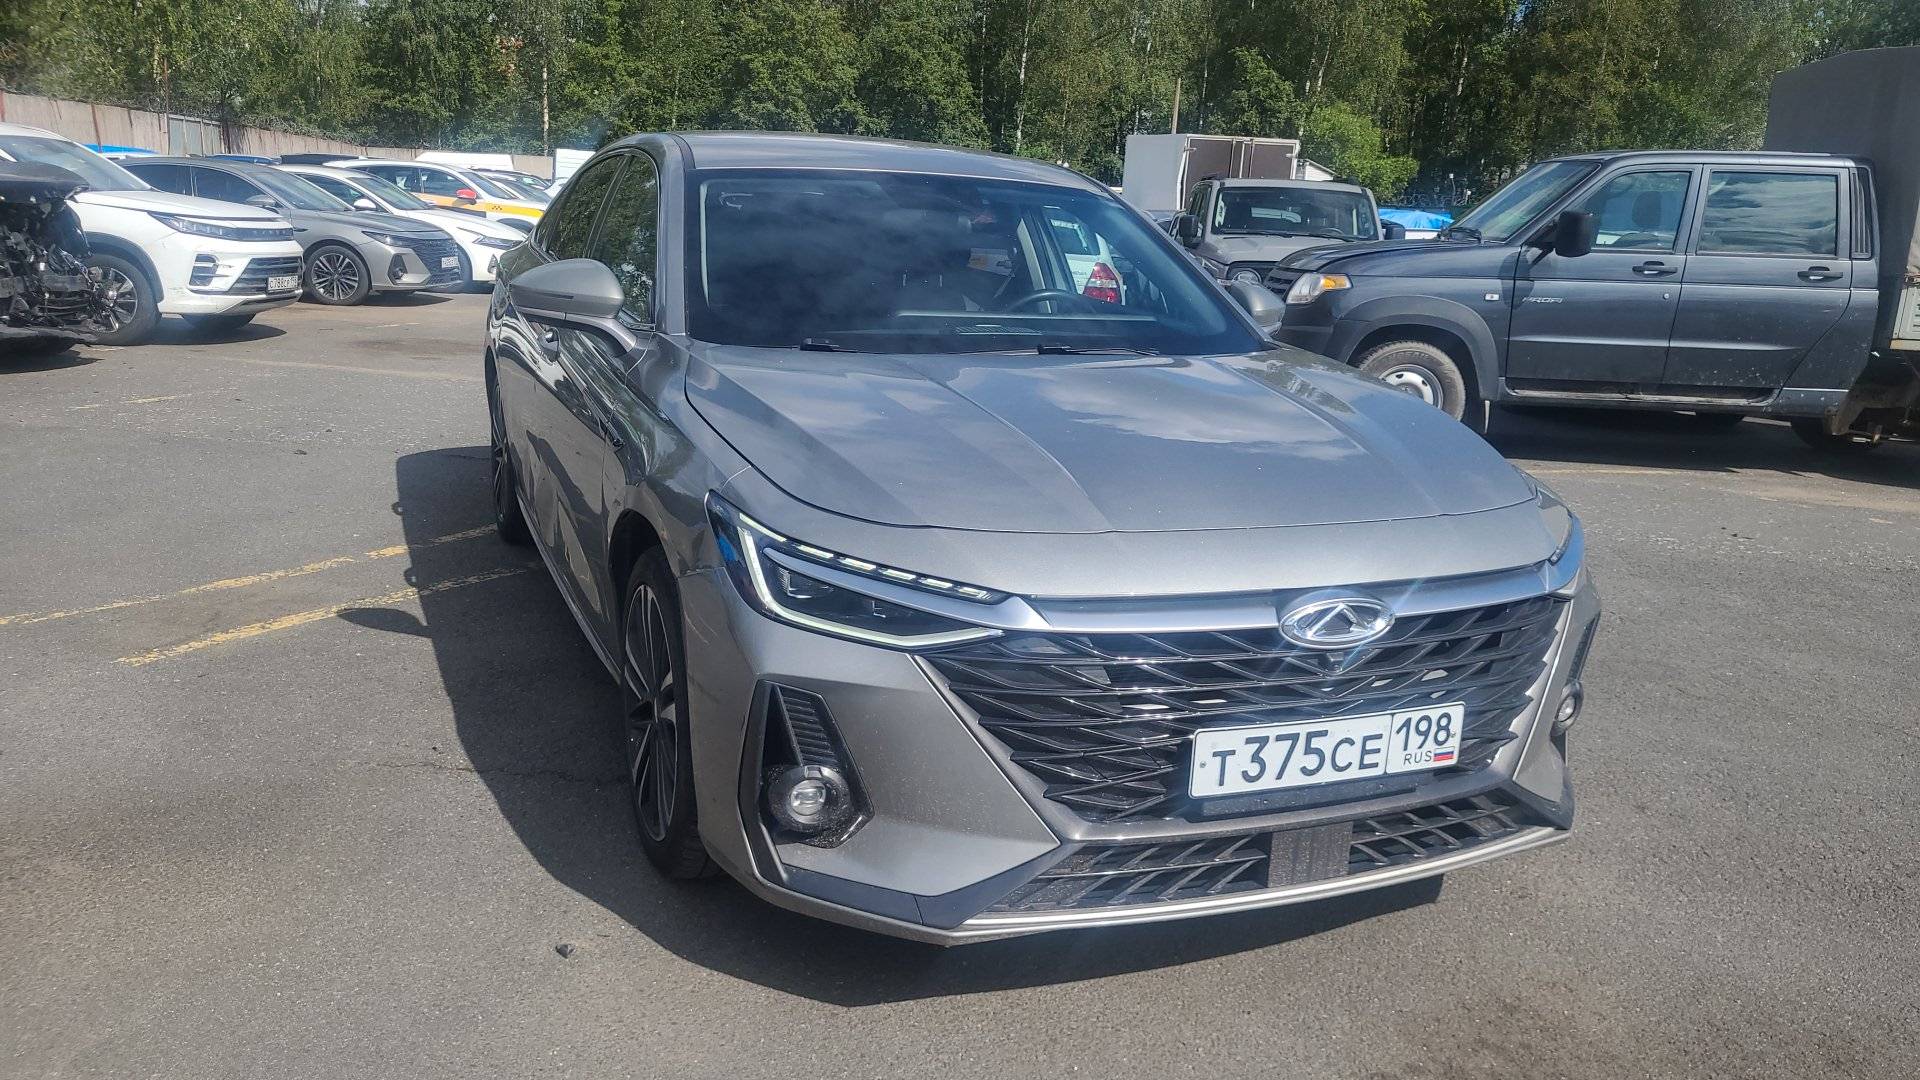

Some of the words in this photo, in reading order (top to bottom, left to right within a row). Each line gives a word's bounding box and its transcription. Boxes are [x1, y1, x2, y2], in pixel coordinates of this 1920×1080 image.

[1211, 729, 1384, 787] Т375СЕ
[1395, 711, 1453, 752] 198
[1403, 751, 1433, 765] RUS
